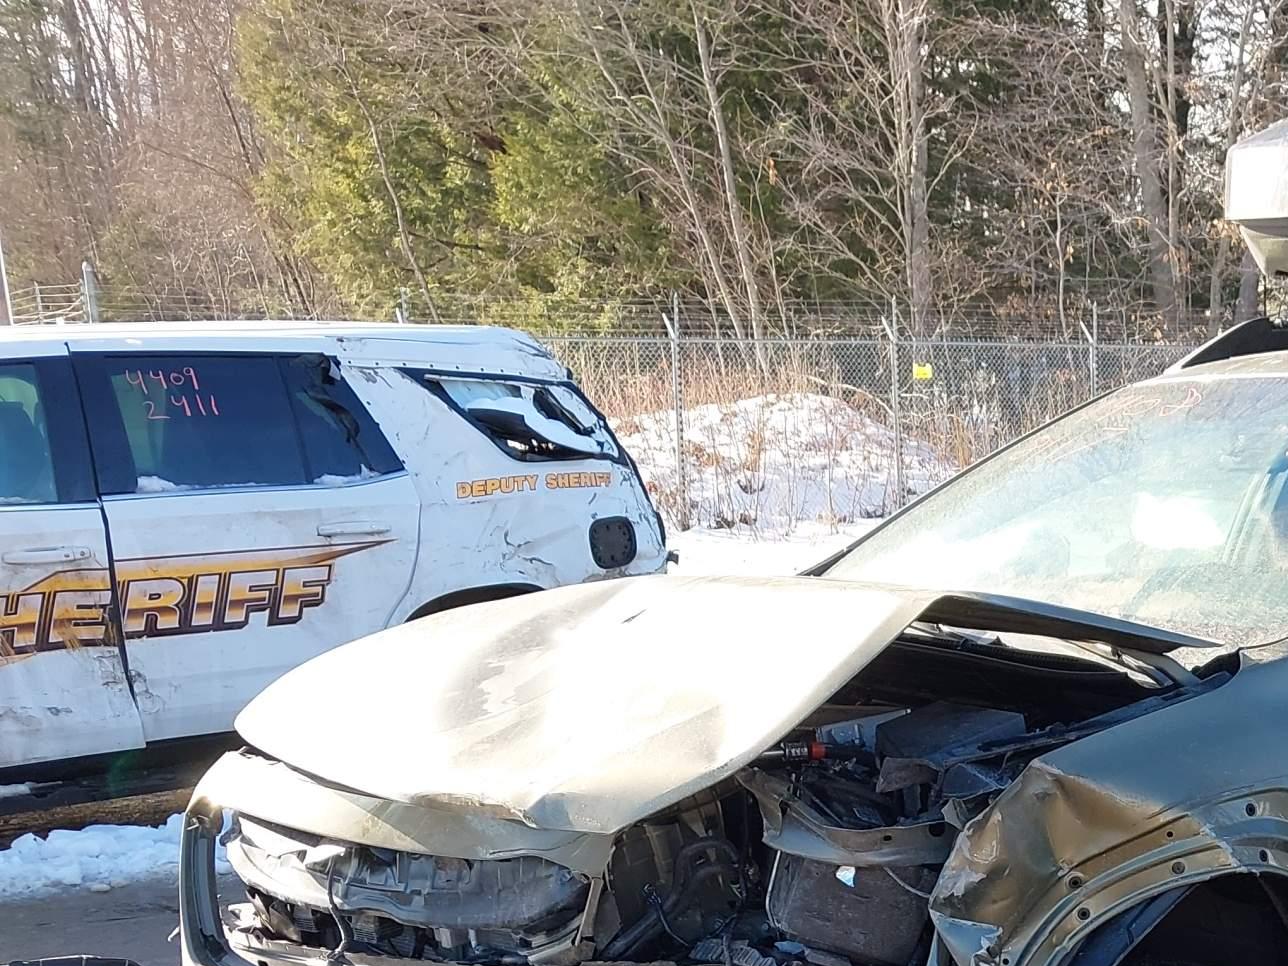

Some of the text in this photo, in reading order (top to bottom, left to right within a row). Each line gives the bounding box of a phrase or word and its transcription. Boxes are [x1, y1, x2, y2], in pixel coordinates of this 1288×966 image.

[125, 366, 199, 395] 4409
[142, 393, 219, 420] 2411
[456, 472, 612, 499] DEPUTY SHERIFF
